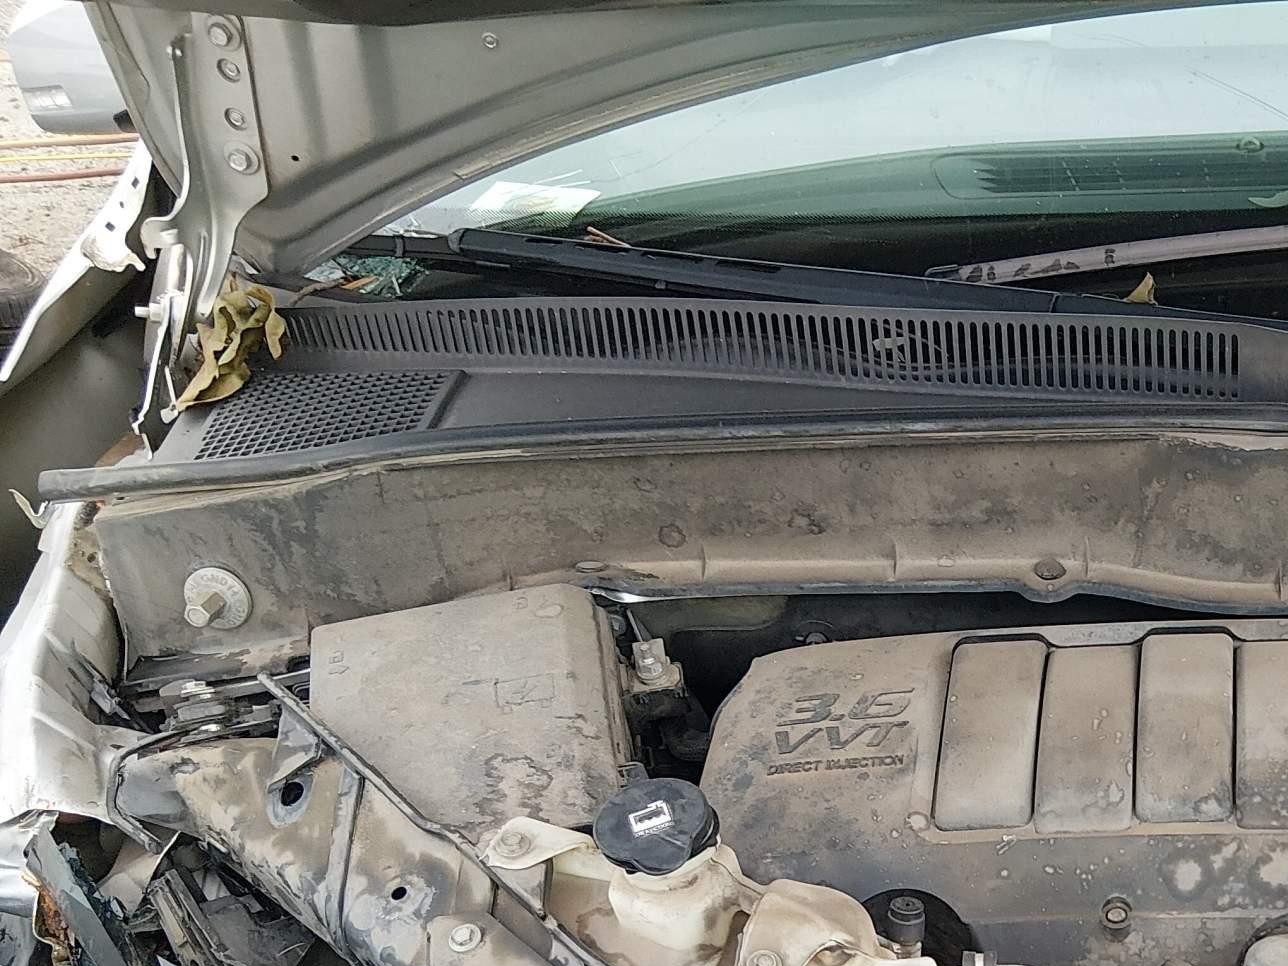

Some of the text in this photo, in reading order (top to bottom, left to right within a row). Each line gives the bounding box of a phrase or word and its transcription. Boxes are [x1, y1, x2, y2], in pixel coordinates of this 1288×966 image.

[776, 687, 915, 727] 3.6
[775, 720, 910, 755] VVT
[767, 754, 905, 776] DIRECT INJECTION
